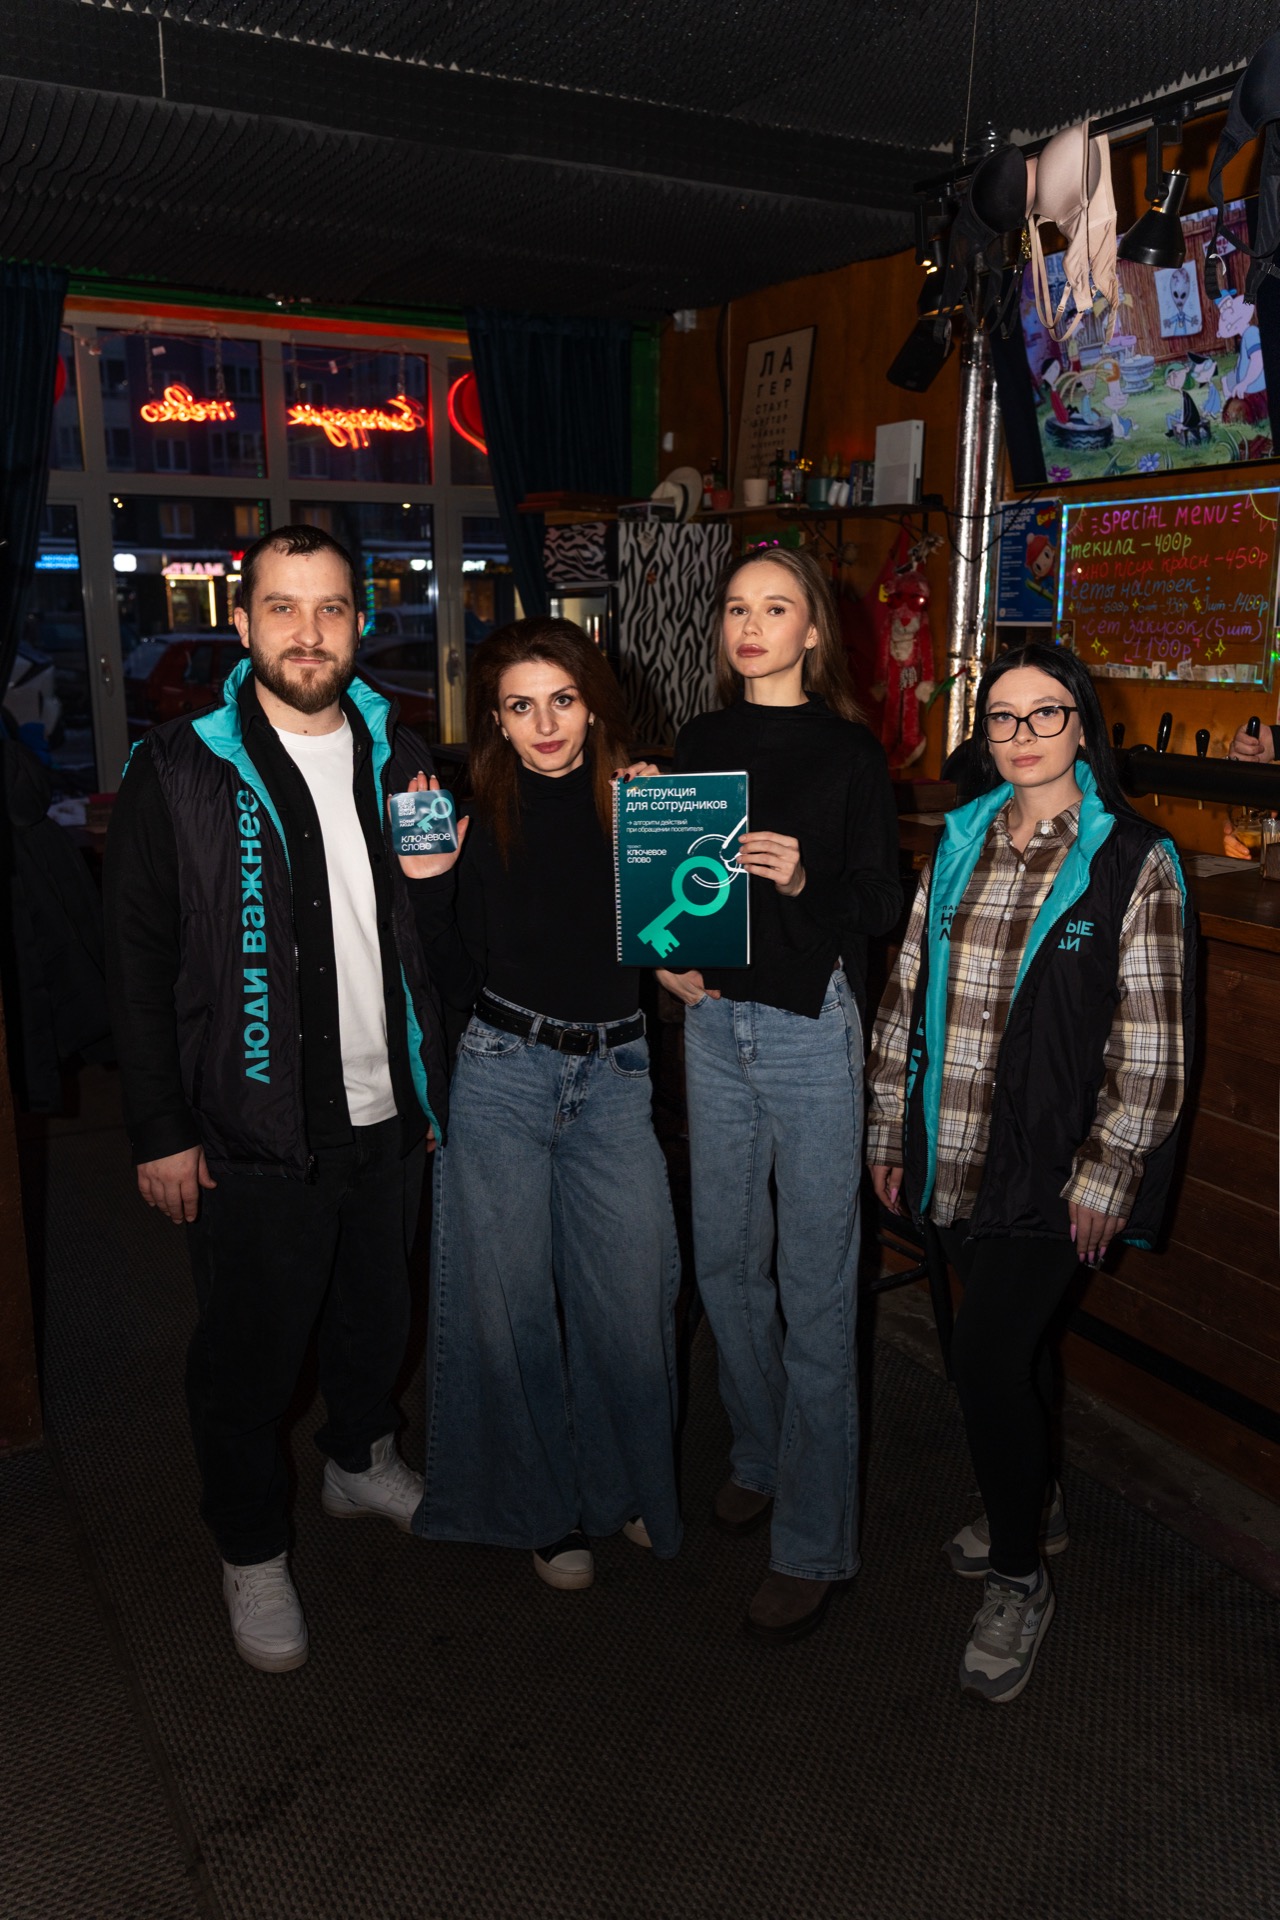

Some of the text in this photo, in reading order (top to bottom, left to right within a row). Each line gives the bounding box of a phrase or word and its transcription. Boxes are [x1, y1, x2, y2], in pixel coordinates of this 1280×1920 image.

[1070, 536, 1136, 560] текила
[626, 787, 696, 800] инструкция
[626, 800, 727, 812] для сотрудников
[401, 833, 451, 843] ключевое
[401, 842, 432, 851] слово
[626, 849, 667, 857] ключевое
